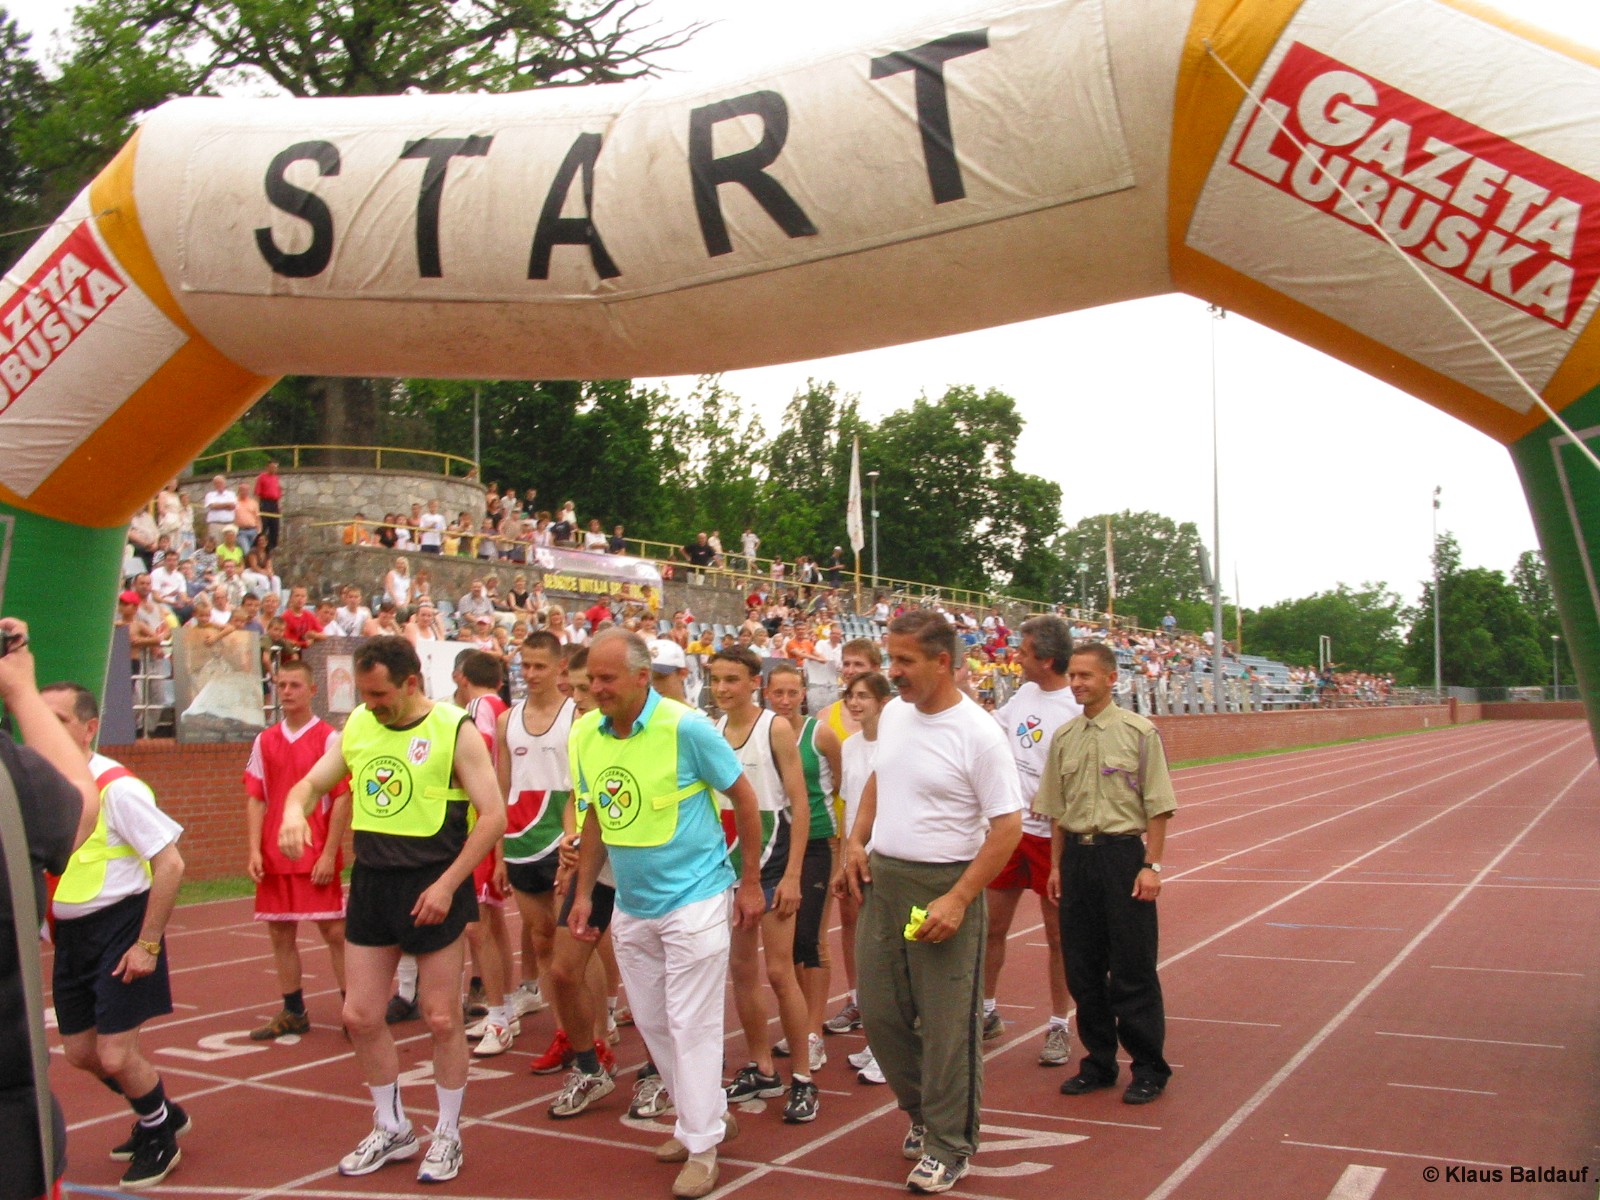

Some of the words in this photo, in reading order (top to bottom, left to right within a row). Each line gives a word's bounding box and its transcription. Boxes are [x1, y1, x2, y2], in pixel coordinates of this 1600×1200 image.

[255, 27, 989, 281] START
[1235, 98, 1575, 323] LUBUSKA
[1297, 70, 1582, 260] GAZETA
